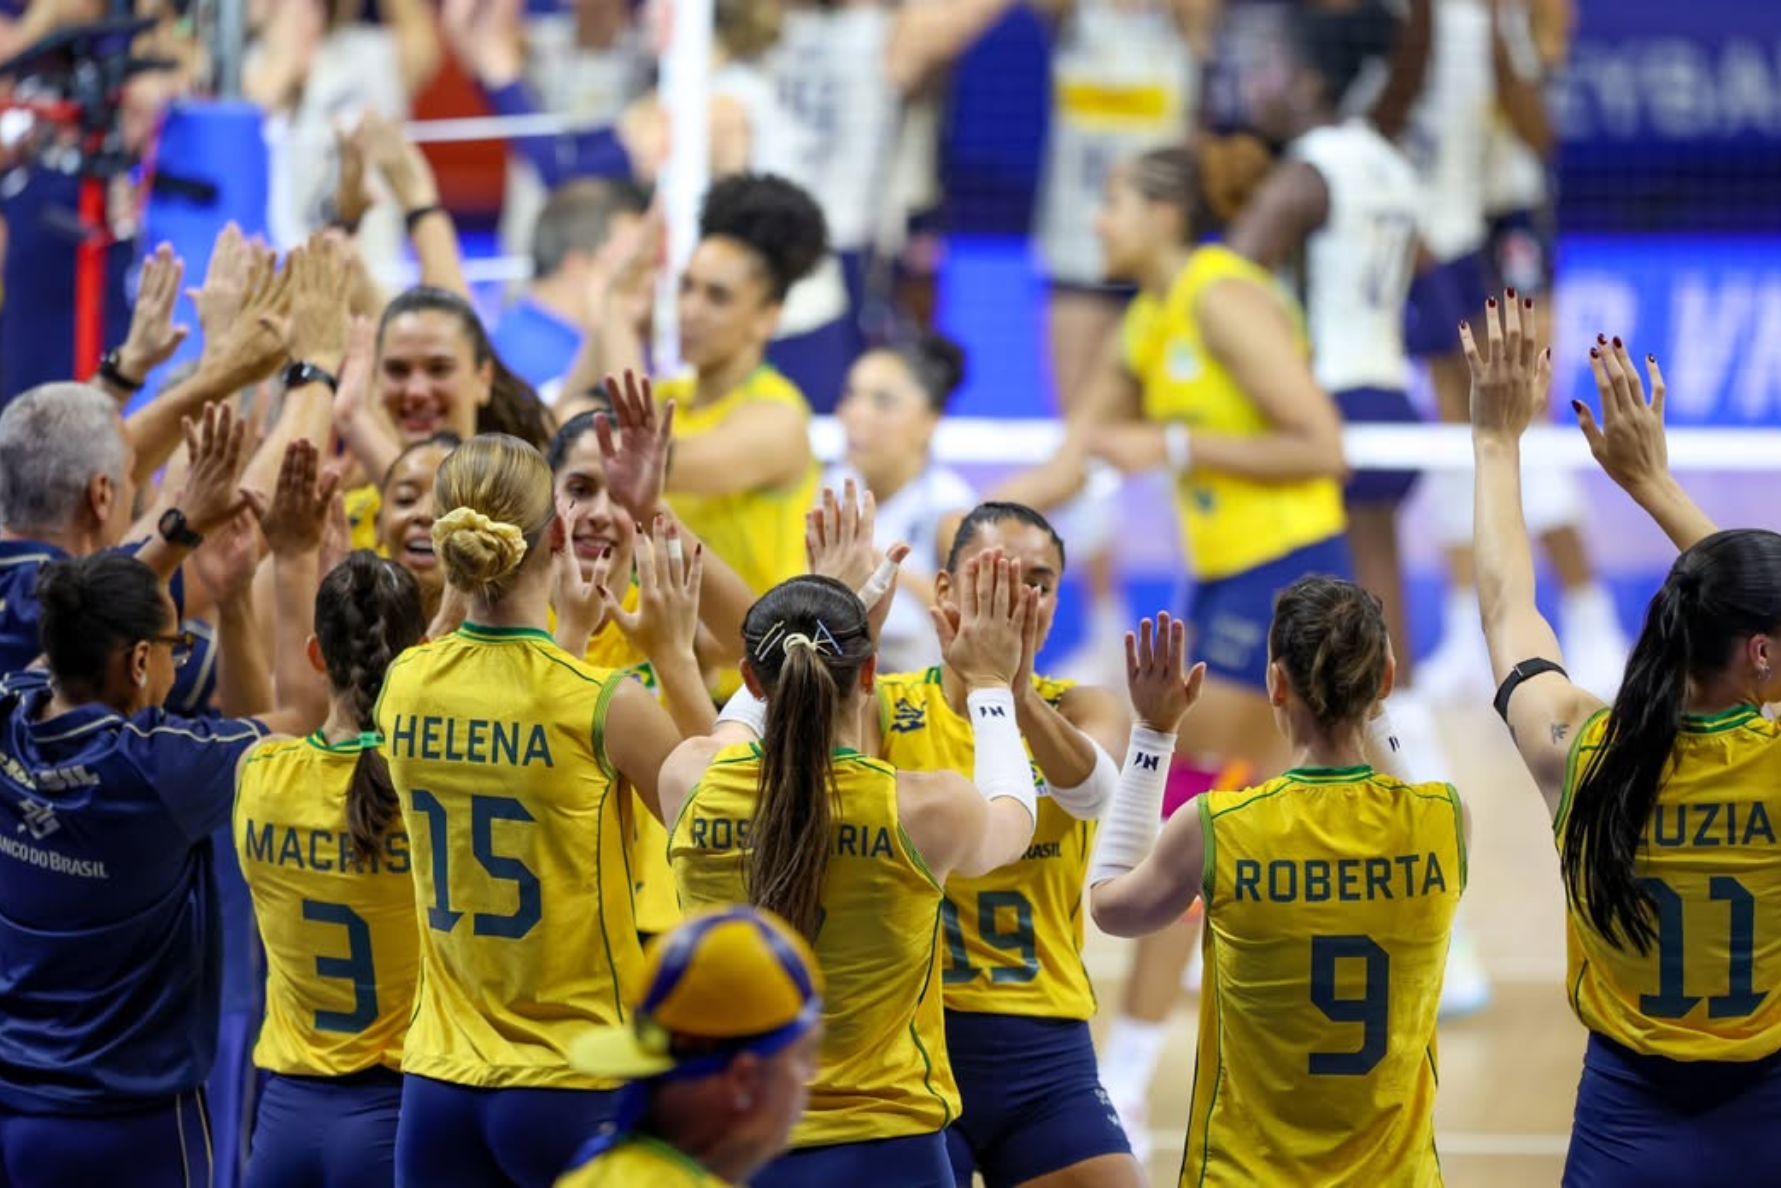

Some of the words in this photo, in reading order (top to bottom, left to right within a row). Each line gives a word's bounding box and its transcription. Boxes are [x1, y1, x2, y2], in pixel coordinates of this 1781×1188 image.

[393, 714, 554, 768] HELENA
[692, 818, 894, 858] ROSRIA
[1638, 801, 1777, 847] UZIA
[29, 846, 48, 868] DO
[49, 850, 109, 879] BRASIL
[411, 789, 542, 939] 15
[1235, 852, 1446, 903] ROBERTA
[302, 899, 379, 1033] 3
[942, 890, 1040, 983] 19
[1634, 876, 1770, 1019] 11
[1308, 934, 1390, 1076] 9
